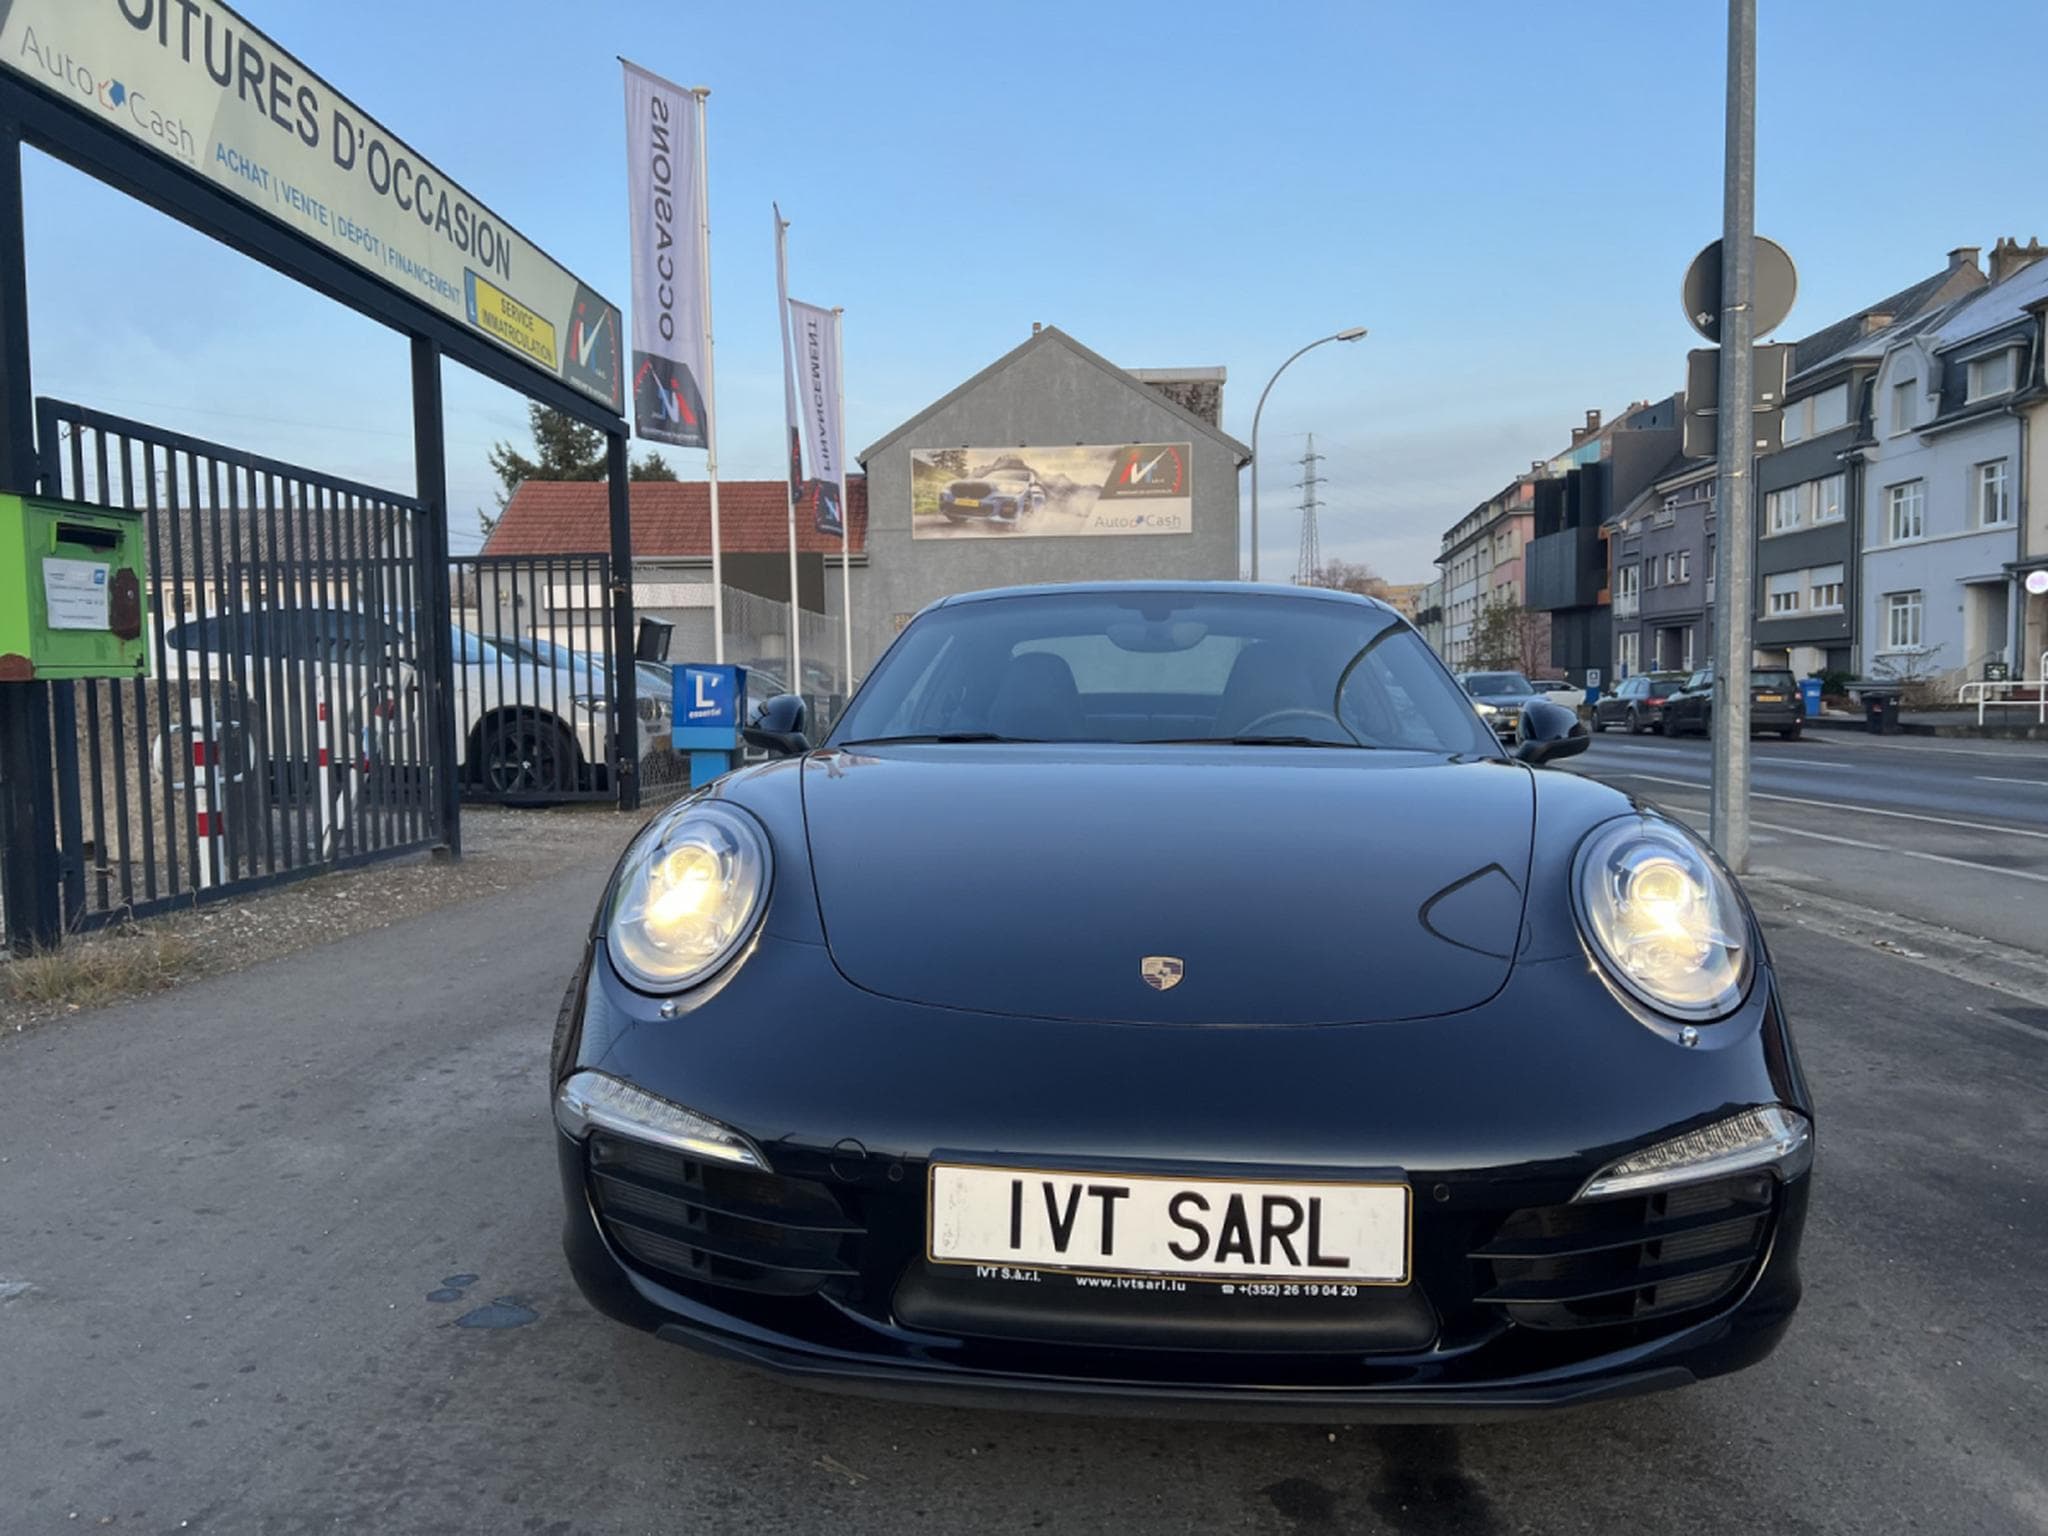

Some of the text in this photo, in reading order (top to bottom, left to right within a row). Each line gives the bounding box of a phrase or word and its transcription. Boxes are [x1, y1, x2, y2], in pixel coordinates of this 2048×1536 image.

[20, 26, 195, 156] Auto Cash
[216, 142, 460, 304] ACHAT VENTE DÉPÔT FINANCEMENT
[501, 298, 534, 332] SERVICE
[1094, 513, 1181, 529] Auto Cash
[1167, 1190, 1351, 1269] SARL
[976, 1266, 998, 1279] IVT
[1076, 1276, 1186, 1292] www.ivtsarl.lu
[1239, 1284, 1358, 1297] +(352) 26 19 04 20
